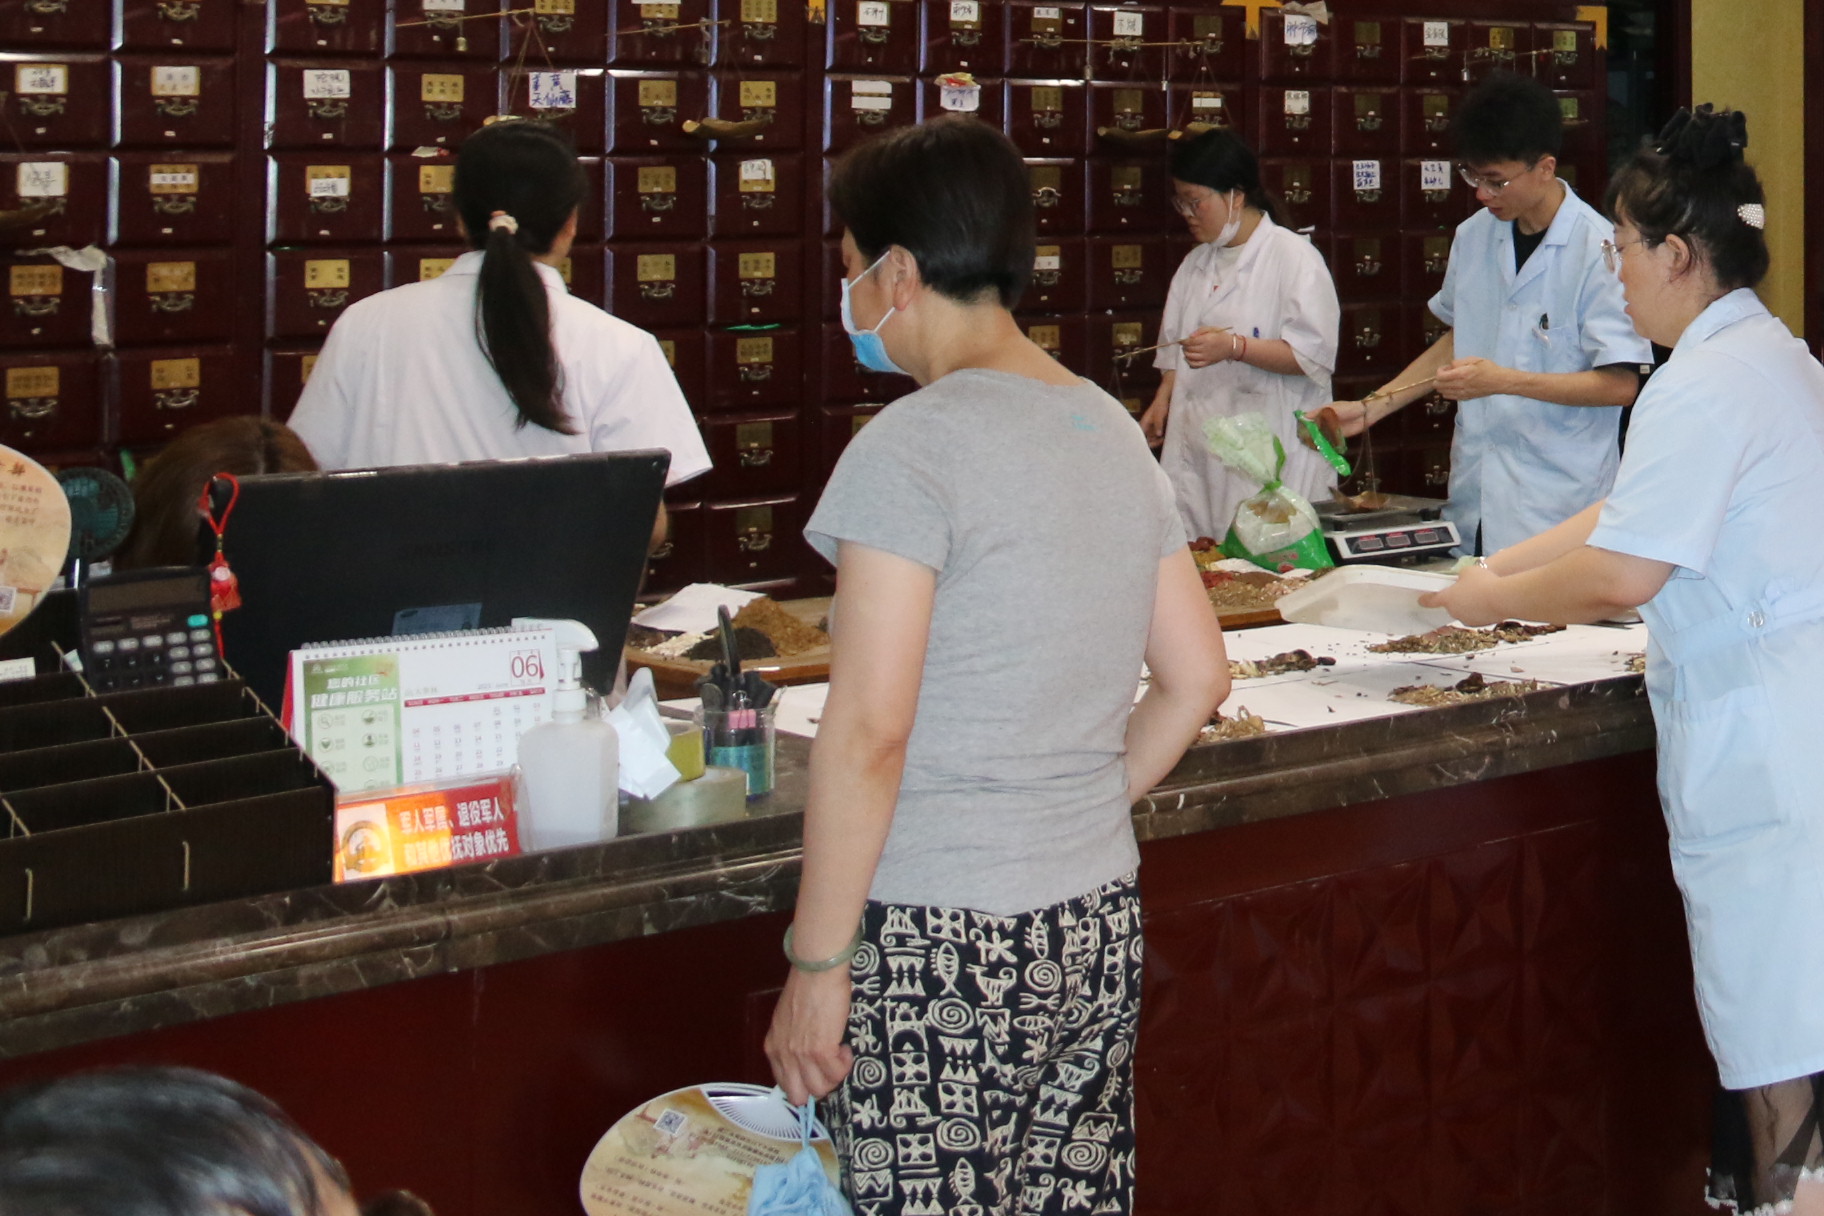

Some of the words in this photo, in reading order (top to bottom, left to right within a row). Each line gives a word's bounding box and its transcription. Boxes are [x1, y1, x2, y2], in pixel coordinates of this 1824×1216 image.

[511, 654, 539, 678] 06
[311, 687, 398, 709] 健康服务站
[400, 796, 505, 833] 军人军属、退役军人
